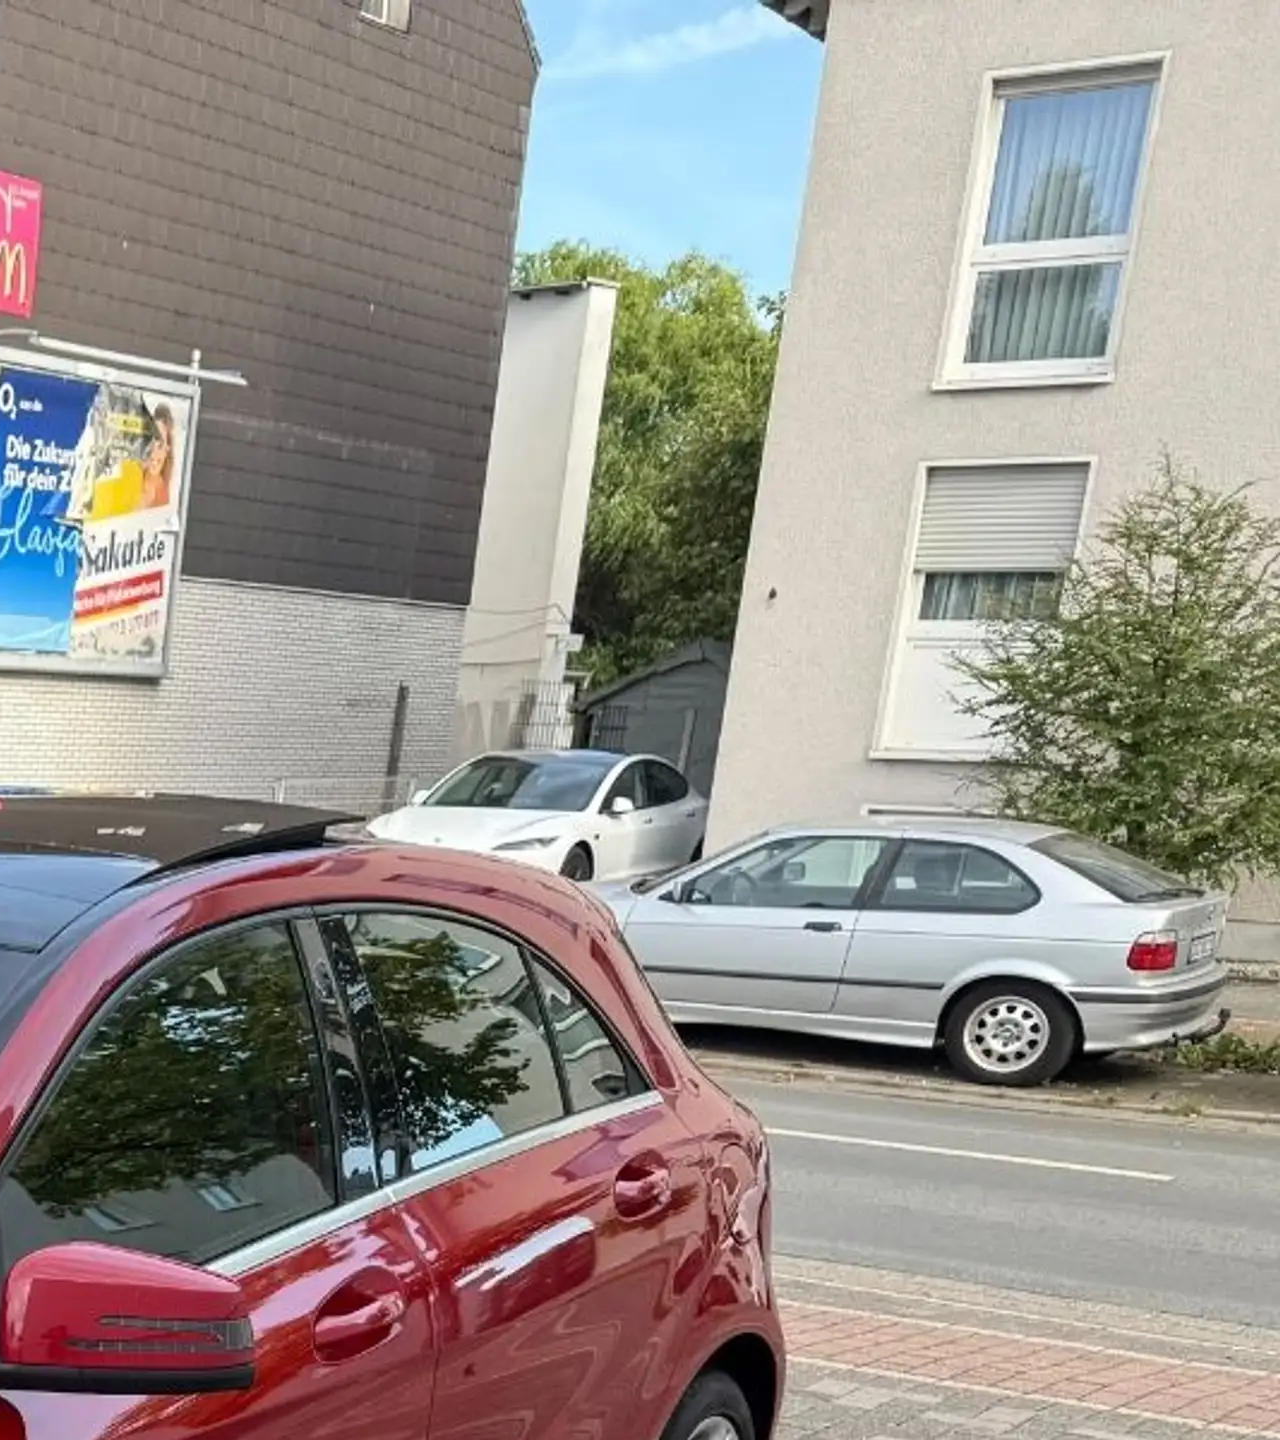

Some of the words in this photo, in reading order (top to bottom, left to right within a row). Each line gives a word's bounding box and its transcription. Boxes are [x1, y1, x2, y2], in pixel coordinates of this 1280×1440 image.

[5, 434, 31, 460] Die
[3, 463, 27, 489] für
[27, 466, 57, 491] dein
